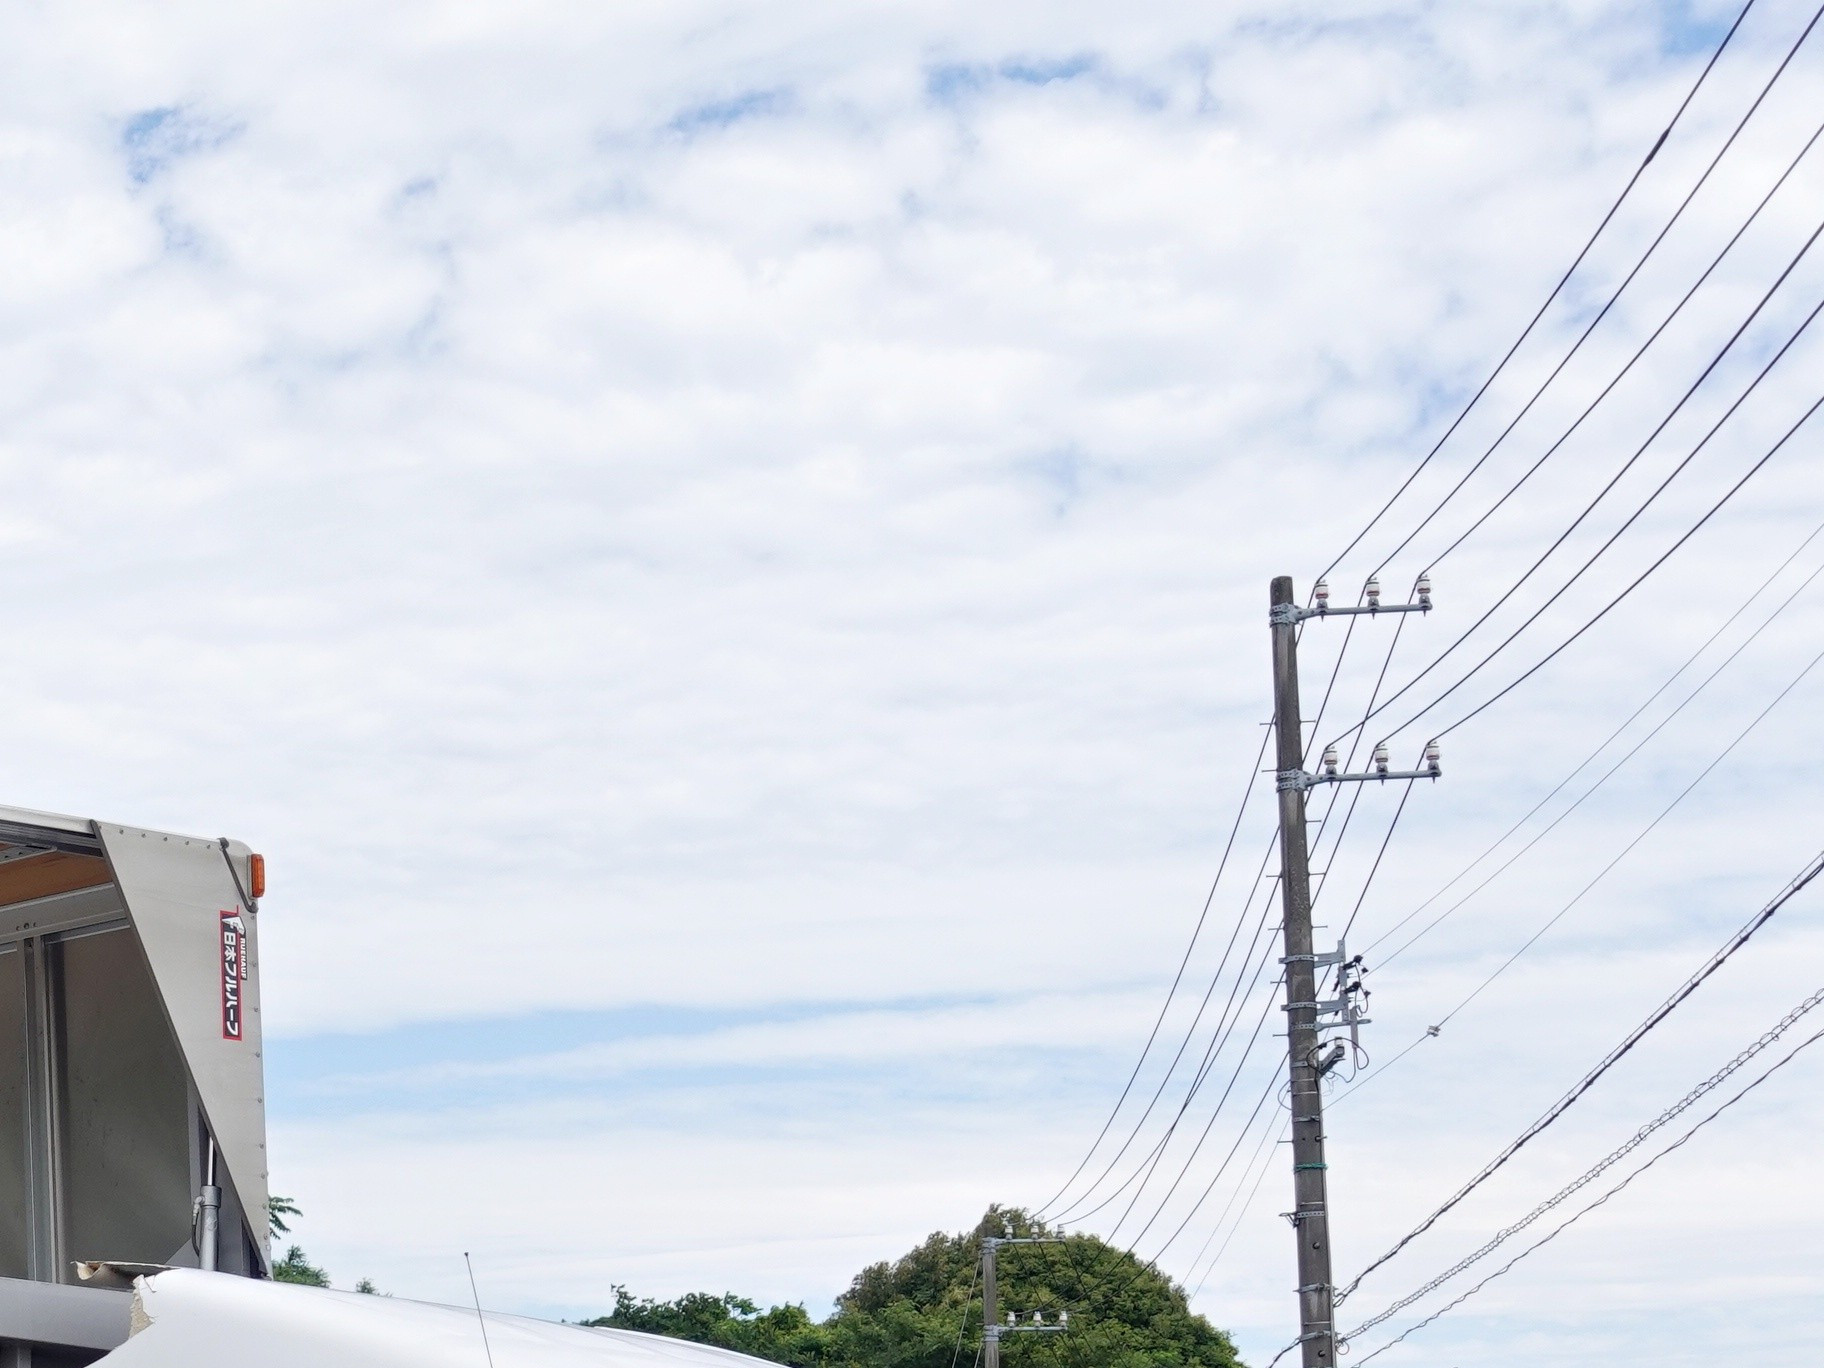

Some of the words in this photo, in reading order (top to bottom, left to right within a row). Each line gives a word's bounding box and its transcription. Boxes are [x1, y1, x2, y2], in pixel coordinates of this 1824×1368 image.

[224, 930, 239, 1036] 日本フルハーフ
